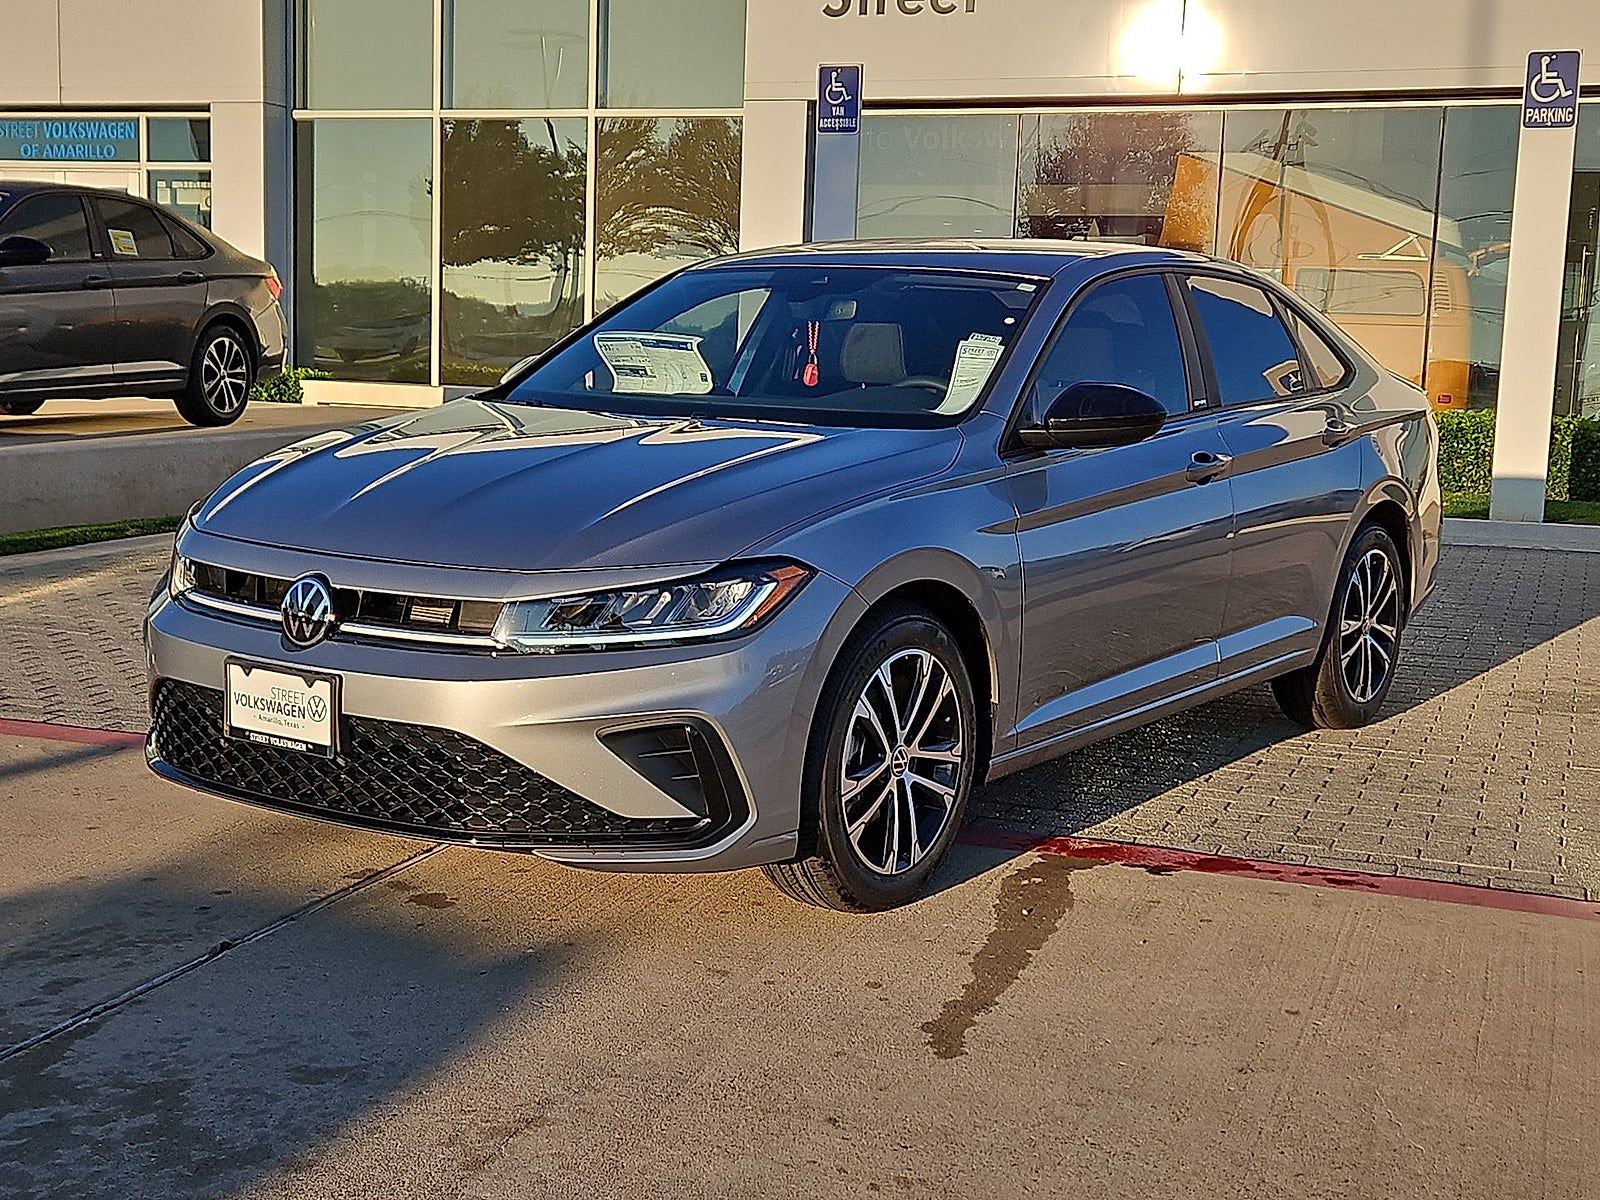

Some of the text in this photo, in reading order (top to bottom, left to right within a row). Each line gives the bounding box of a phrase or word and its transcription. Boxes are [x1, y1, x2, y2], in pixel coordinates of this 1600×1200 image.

[831, 106, 845, 116] VAN
[1525, 107, 1574, 123] PARKING
[43, 121, 136, 139] VOLKSWAGEN
[819, 118, 857, 128] ACCESSIBLE
[20, 143, 116, 158] OF AMARILLO
[270, 686, 306, 706] STREET
[233, 691, 306, 719] VOLKSWAGEN
[284, 719, 300, 730] Texas
